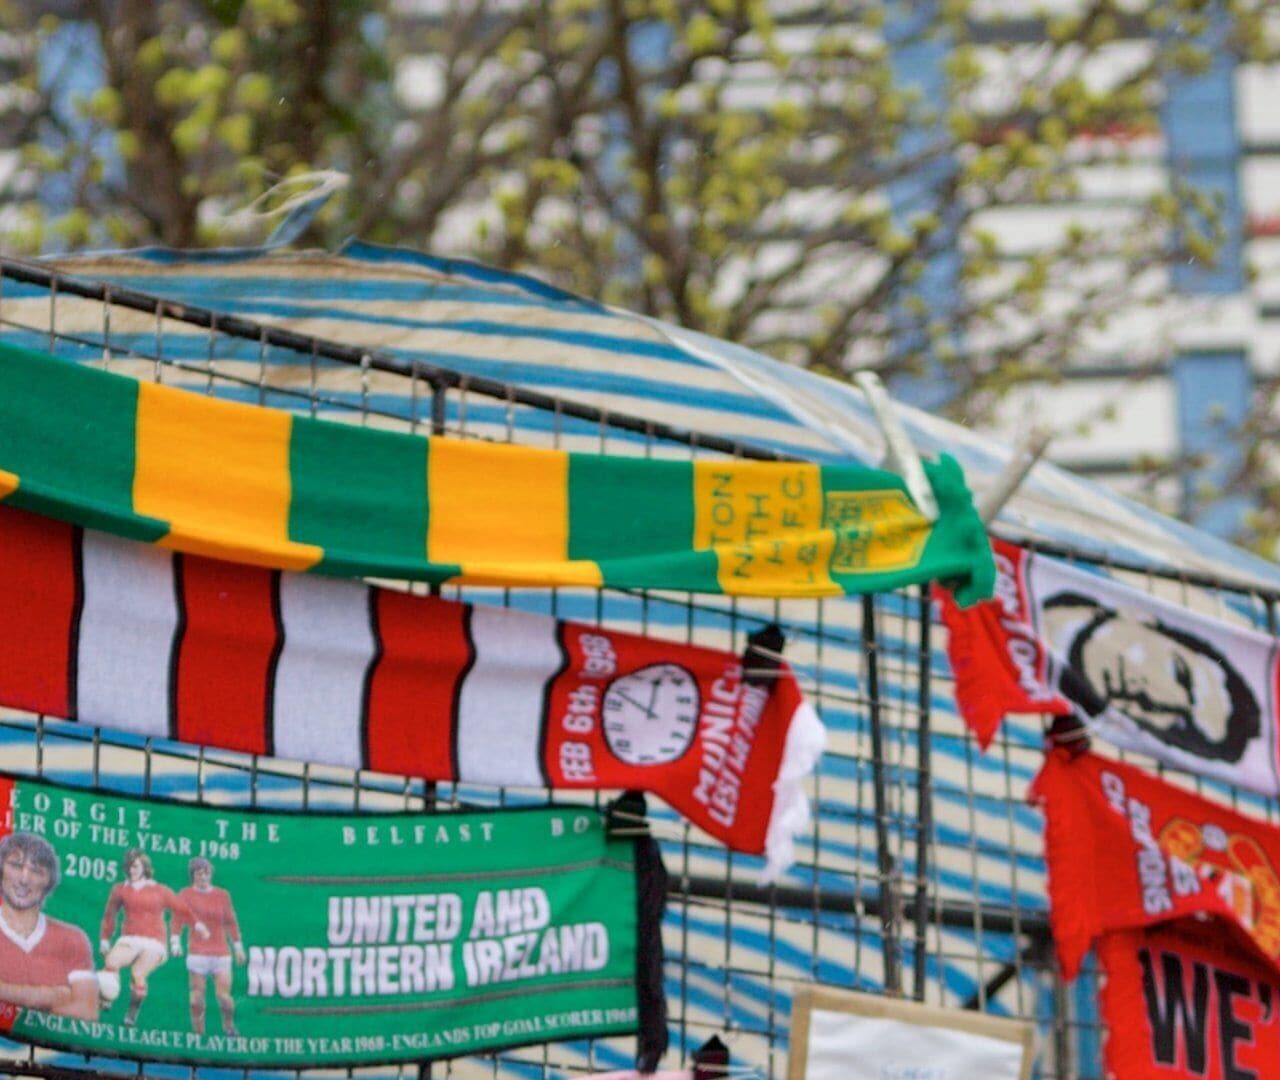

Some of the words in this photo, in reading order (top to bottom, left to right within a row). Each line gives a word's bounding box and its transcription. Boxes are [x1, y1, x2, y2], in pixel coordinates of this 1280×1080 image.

[580, 633, 619, 679] 1958
[562, 686, 599, 735] 6th
[559, 741, 596, 782] FEB
[53, 817, 82, 840] OF
[87, 821, 129, 847] THE
[136, 831, 192, 857] YEAR
[198, 838, 241, 861] 1968
[215, 819, 281, 843] THE
[341, 822, 495, 846] BELFAST
[63, 852, 119, 884] 2005
[326, 892, 463, 946] UNITED
[468, 885, 551, 939] AND
[246, 943, 455, 998] NORTHERN
[461, 921, 610, 988] IRELAND
[23, 1009, 117, 1041] ENGLAND'S
[118, 1027, 184, 1049] LEAGUE
[185, 1032, 250, 1053] PLAYER
[250, 1037, 269, 1055] OF
[273, 1036, 306, 1055] THE
[308, 1036, 353, 1055] YEAR
[353, 1034, 385, 1054] 1968
[472, 1021, 502, 1043] TOP
[502, 1016, 542, 1038] GOAL
[542, 1009, 604, 1034] SCORER
